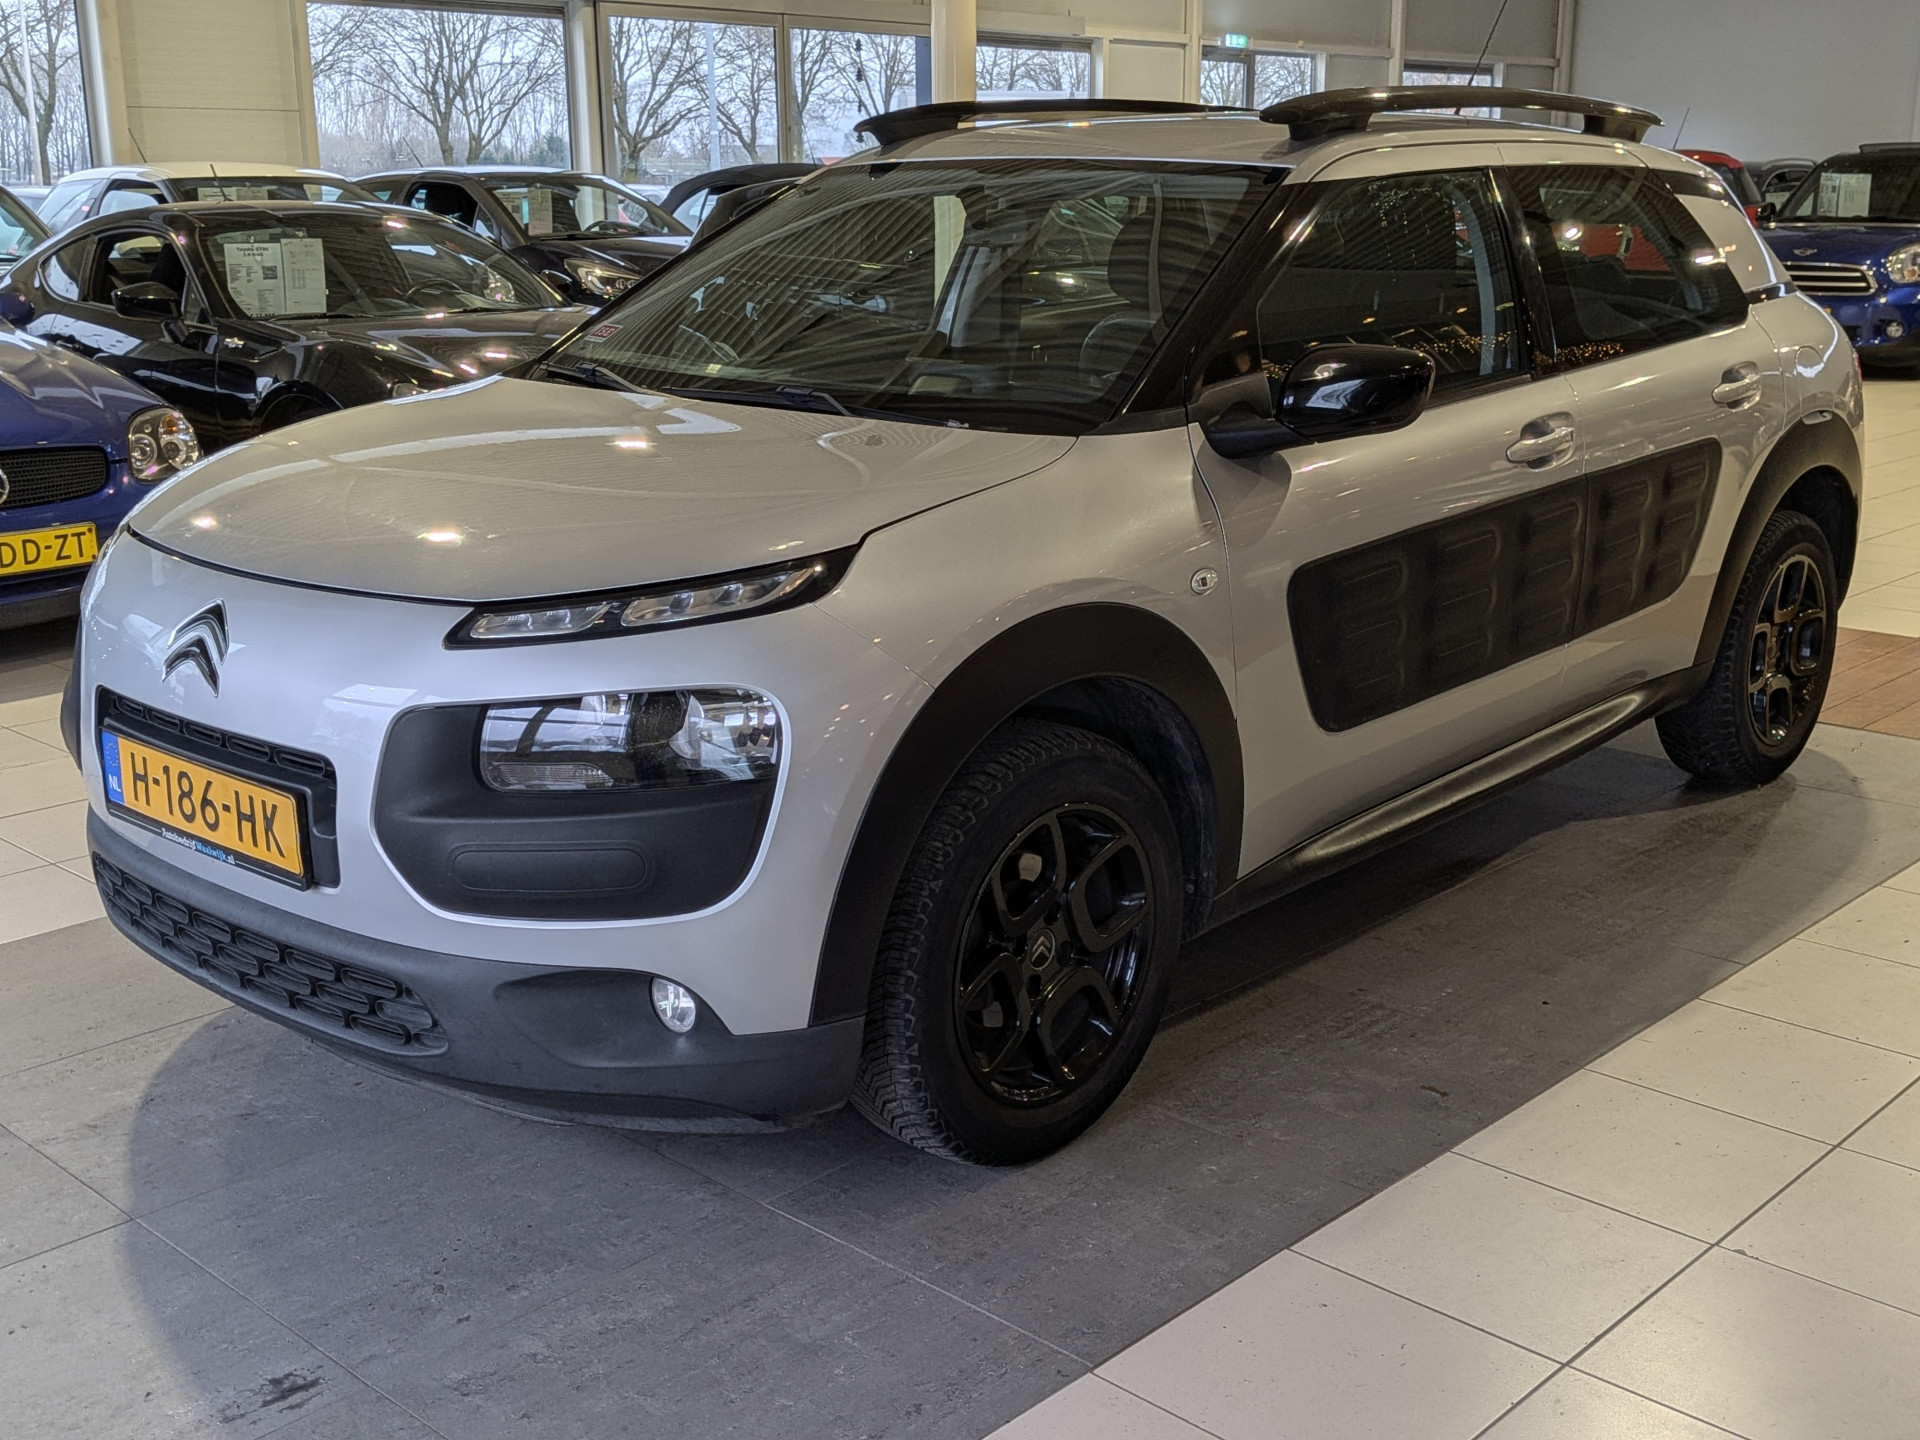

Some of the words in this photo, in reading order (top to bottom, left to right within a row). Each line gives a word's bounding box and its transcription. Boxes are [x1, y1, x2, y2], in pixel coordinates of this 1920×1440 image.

[0, 531, 86, 568] DD-ZT
[108, 773, 121, 793] NL
[130, 752, 287, 858] H-186-HK
